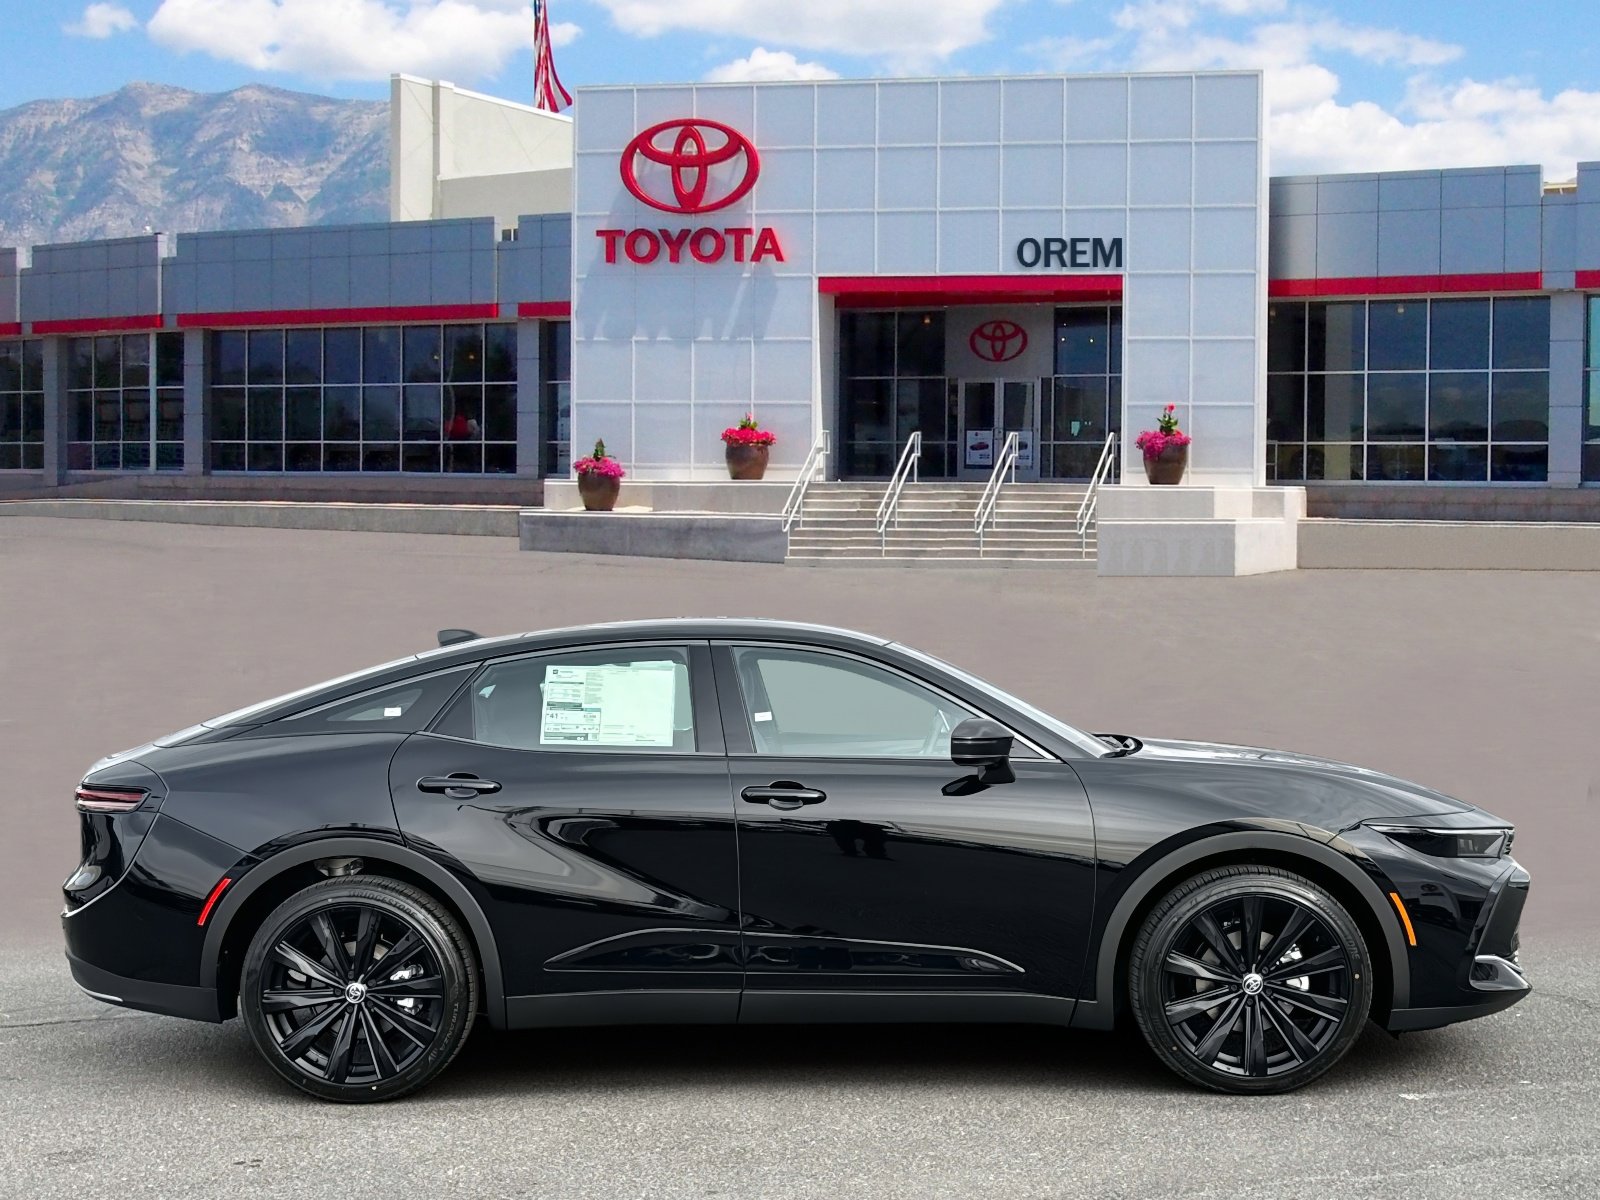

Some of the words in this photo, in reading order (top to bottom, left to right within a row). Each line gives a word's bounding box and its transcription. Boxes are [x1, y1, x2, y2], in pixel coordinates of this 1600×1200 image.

[596, 227, 784, 264] TOYOTA
[1017, 237, 1122, 267] OREM
[440, 1002, 459, 1051] TURANZA
